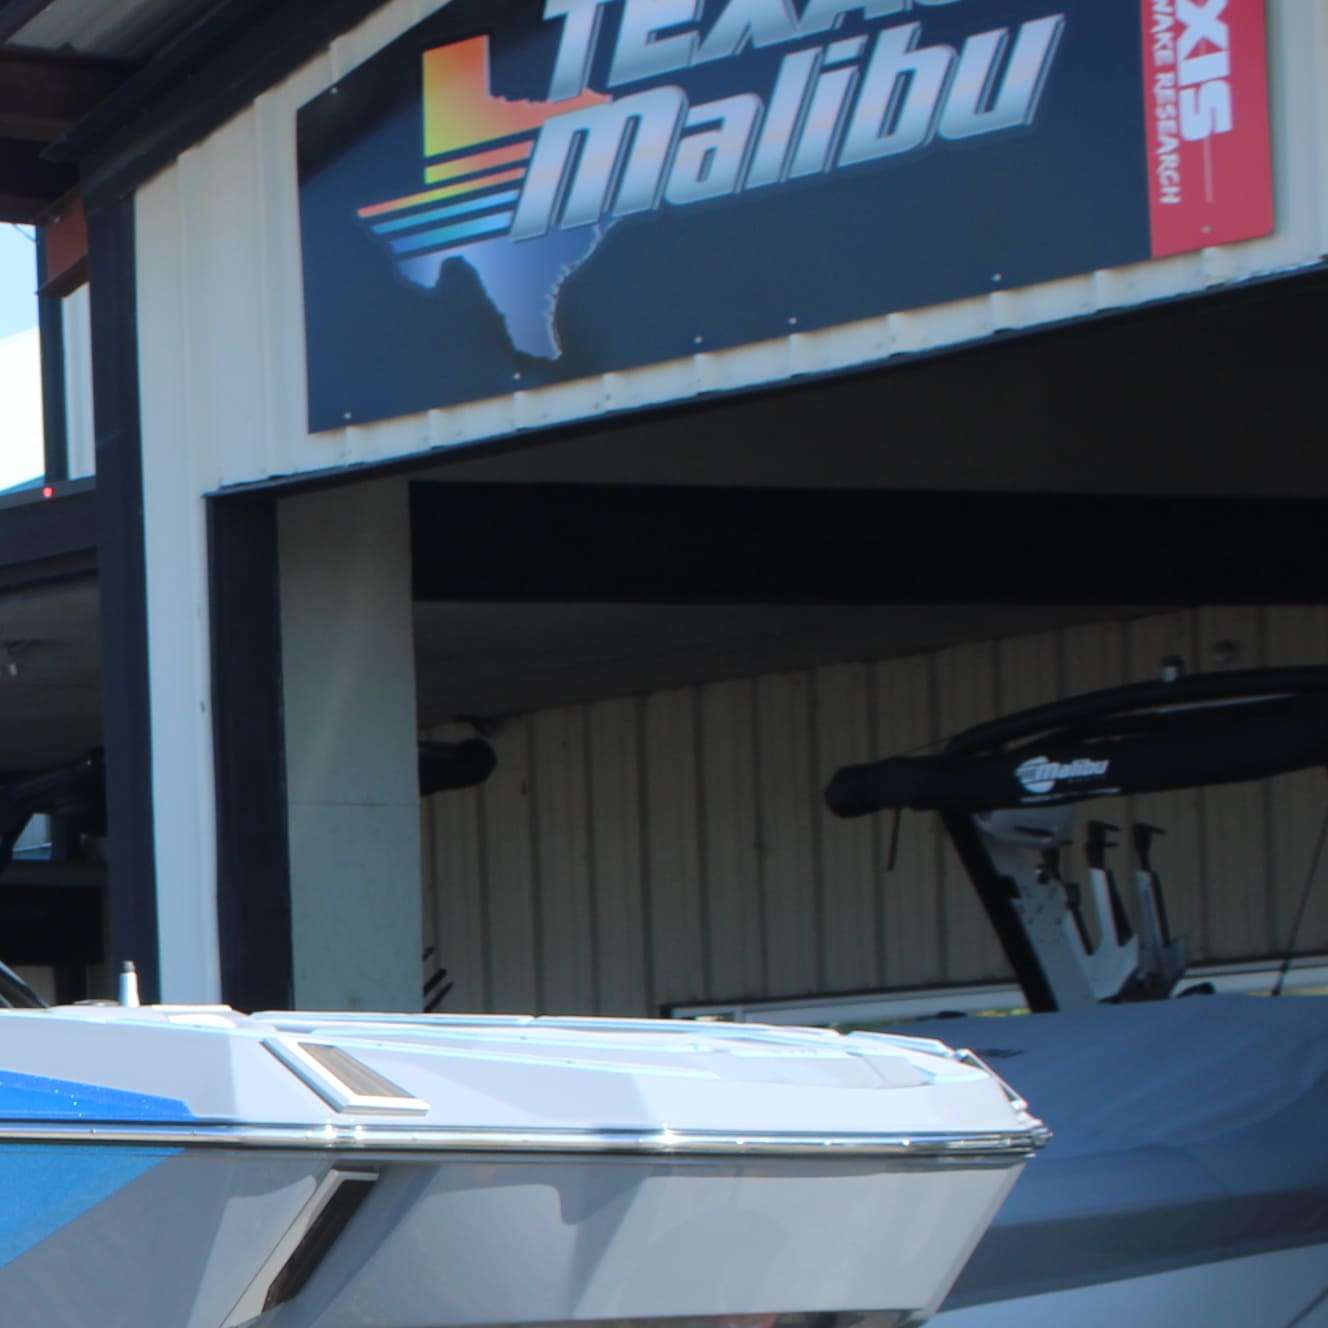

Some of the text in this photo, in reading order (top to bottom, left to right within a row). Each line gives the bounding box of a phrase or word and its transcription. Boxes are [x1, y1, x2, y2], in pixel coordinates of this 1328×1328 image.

[541, 0, 962, 103] TEX
[509, 13, 1066, 243] Malibu
[1153, 72, 1183, 204] RESEARCH
